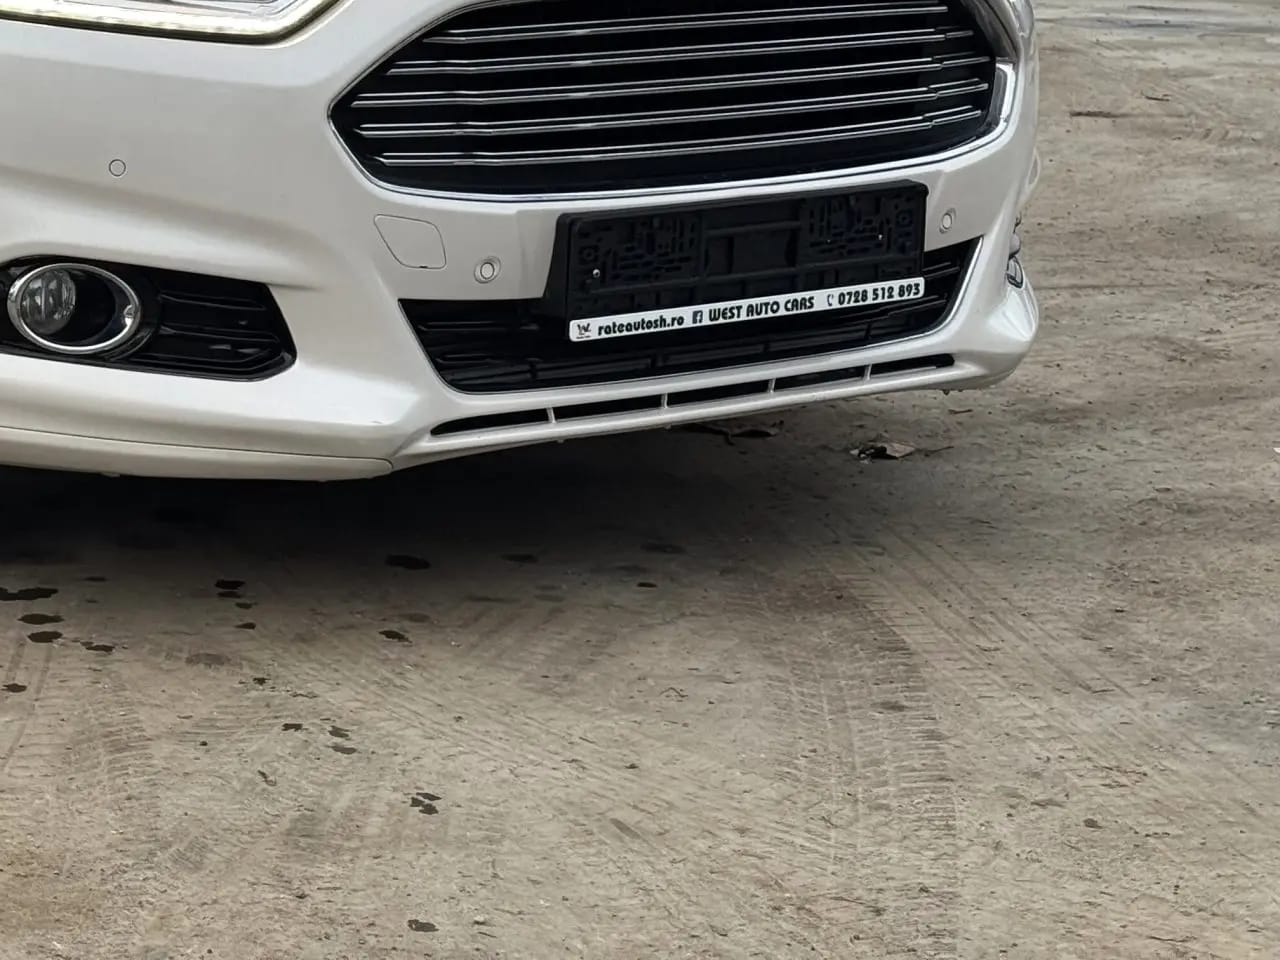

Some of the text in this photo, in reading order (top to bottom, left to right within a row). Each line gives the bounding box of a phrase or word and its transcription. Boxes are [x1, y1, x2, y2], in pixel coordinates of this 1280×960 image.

[708, 305, 743, 321] WEST
[746, 301, 780, 318] AUTO
[784, 296, 815, 312] CARS
[838, 289, 868, 305] 0728
[871, 286, 895, 301] 512
[898, 283, 921, 297] 893
